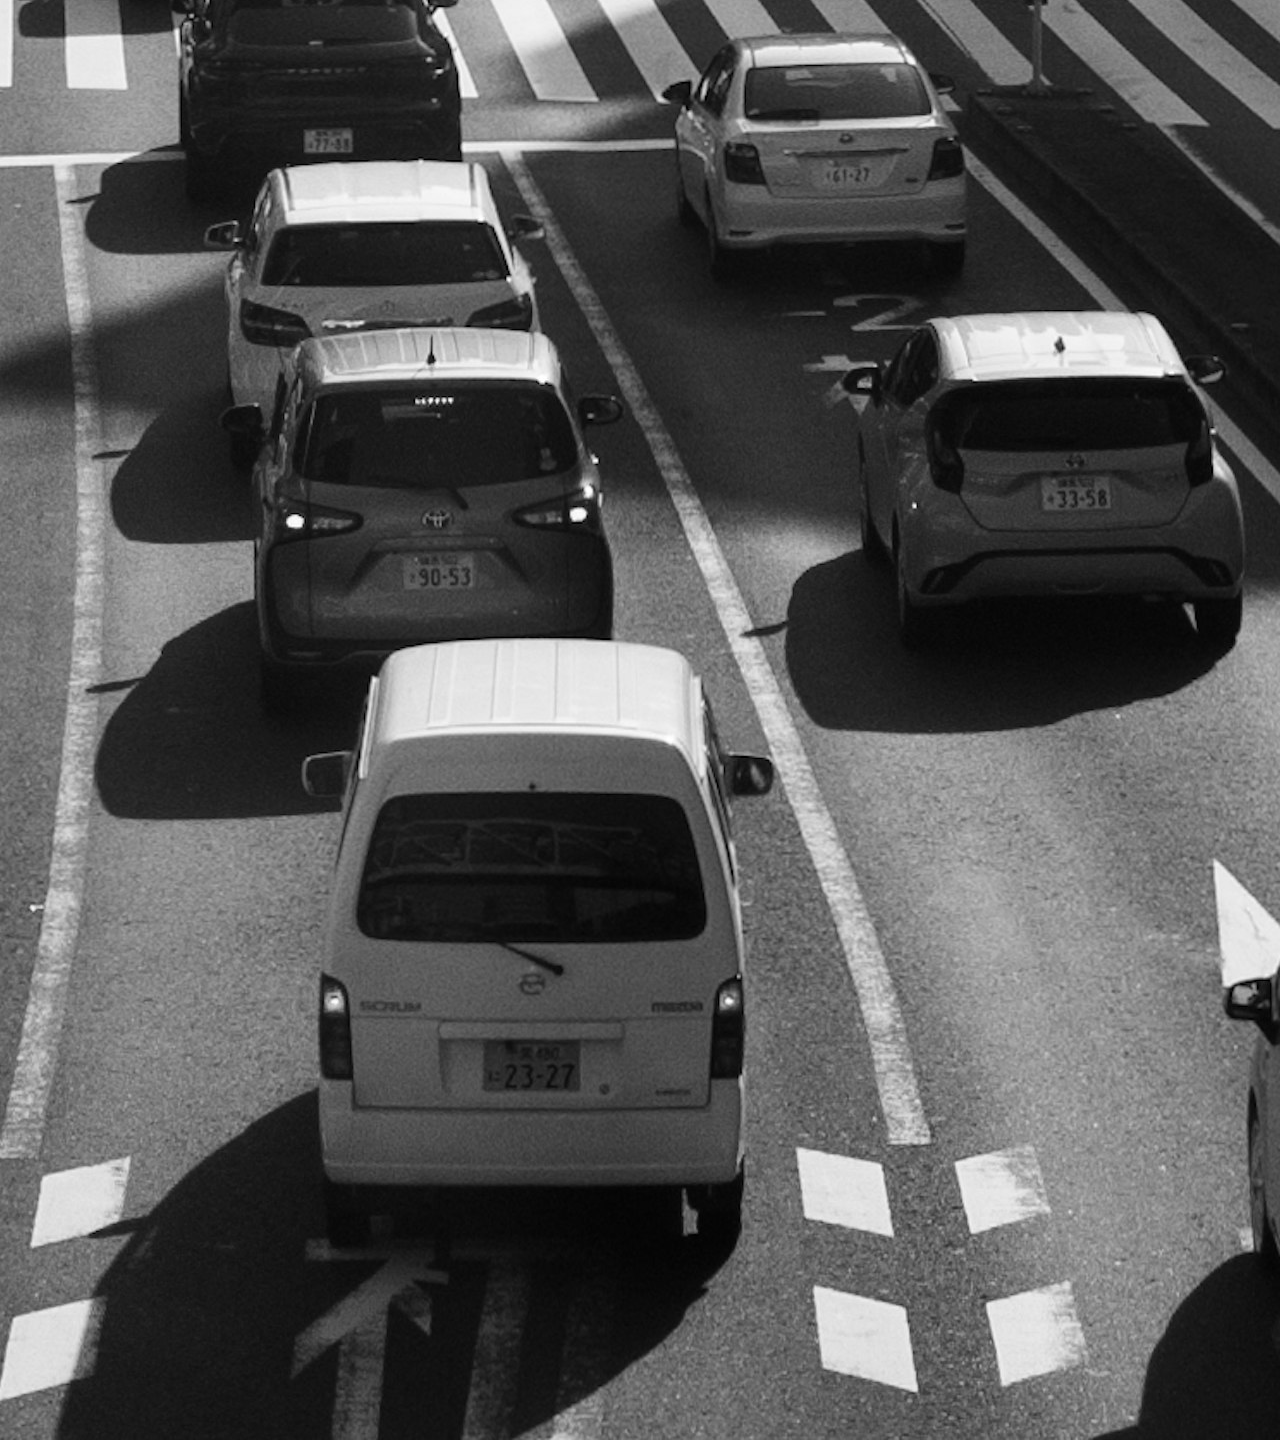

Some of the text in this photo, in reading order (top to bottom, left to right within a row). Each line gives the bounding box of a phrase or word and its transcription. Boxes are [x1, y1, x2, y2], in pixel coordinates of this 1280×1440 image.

[1056, 488, 1108, 509] 33-58
[418, 567, 472, 587] 90-53
[359, 1000, 423, 1013] SCRUM
[503, 1063, 576, 1089] 23-27
